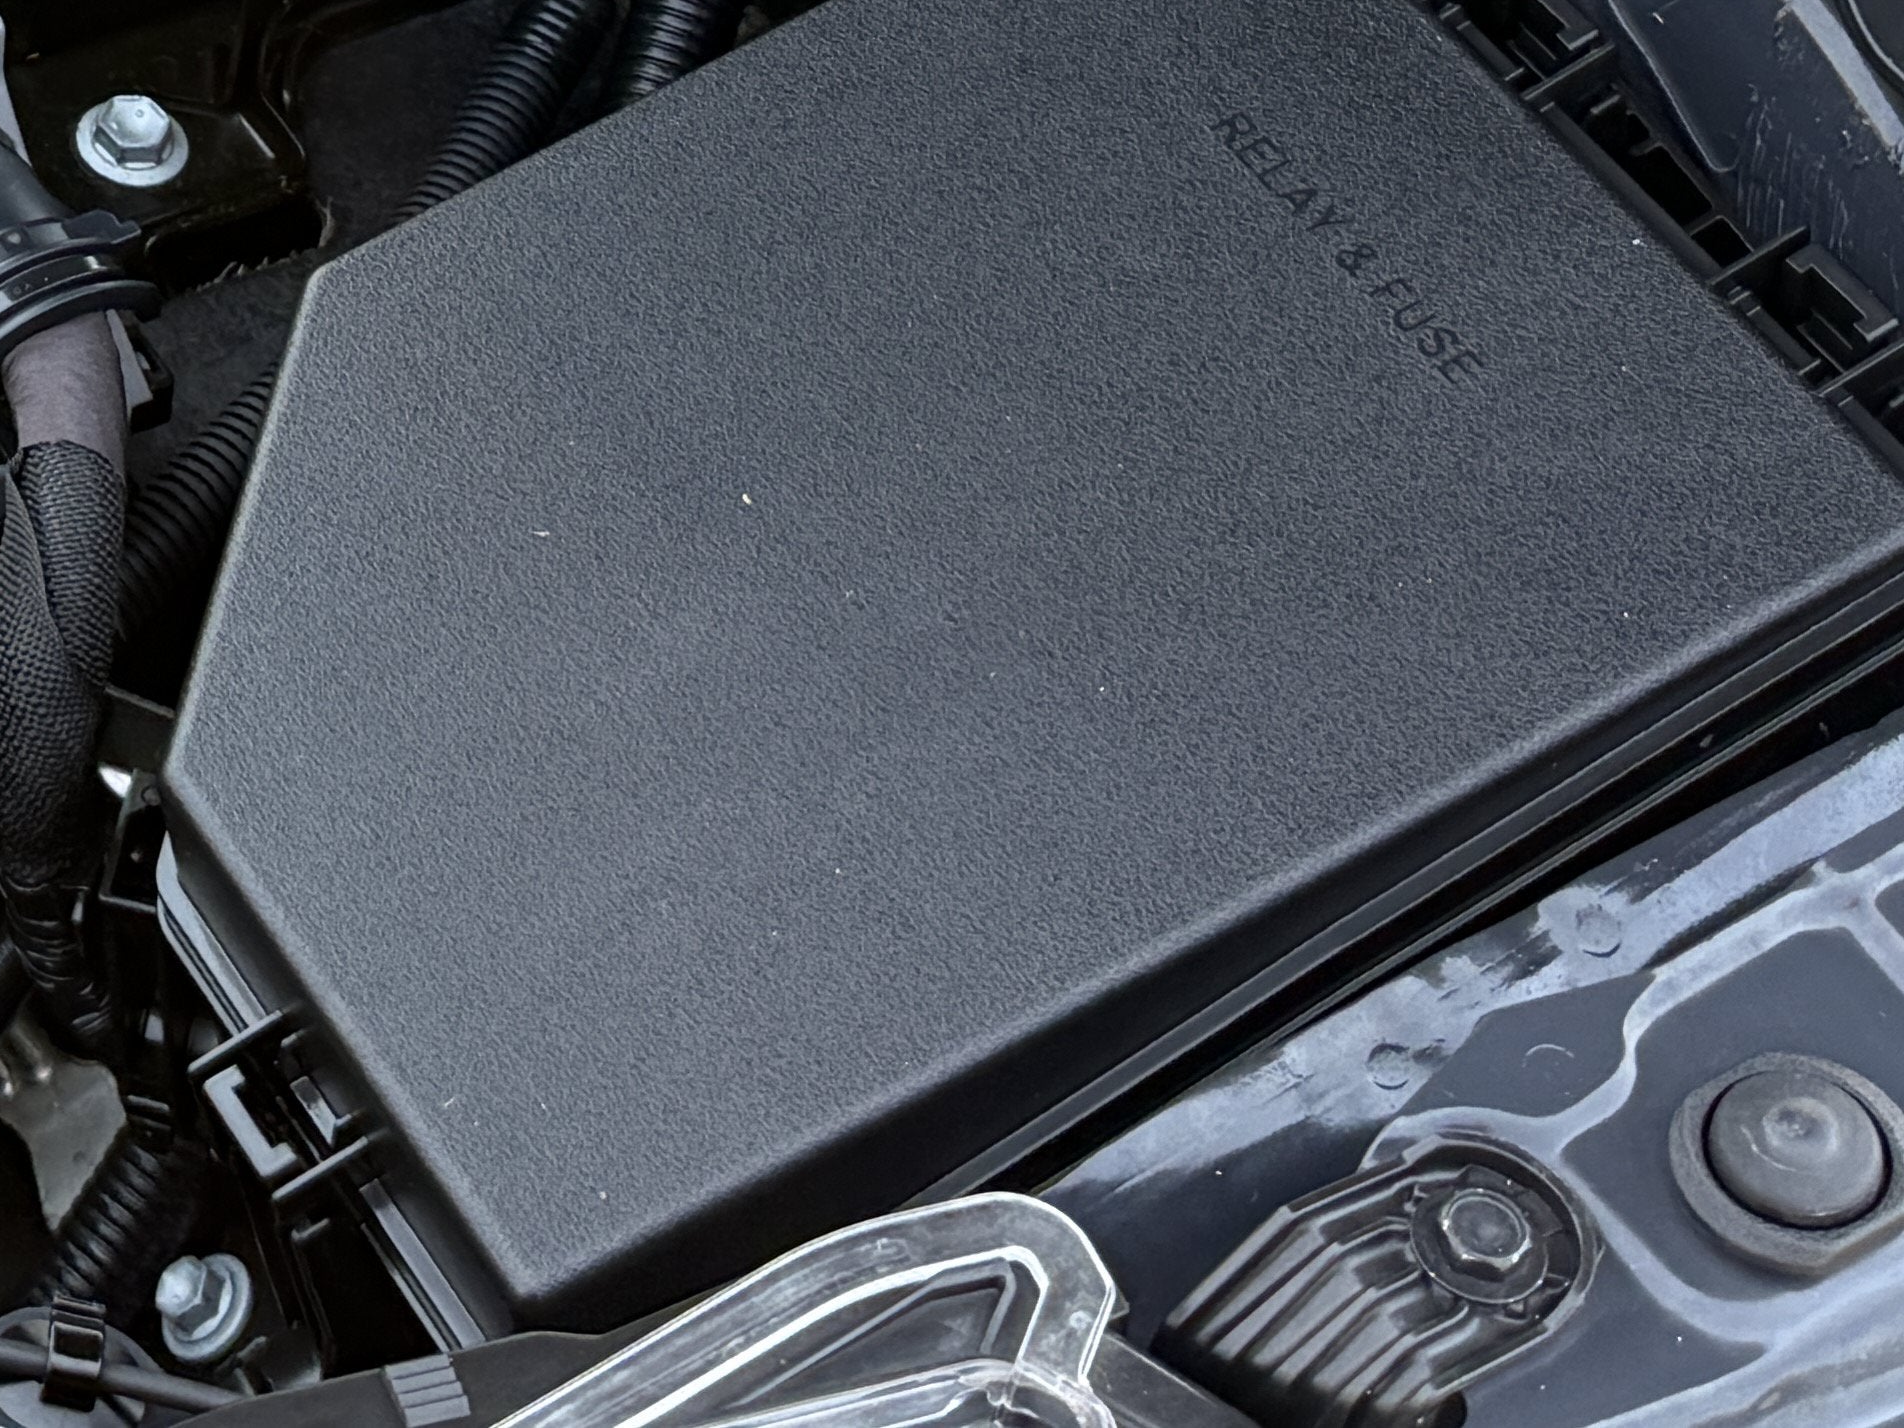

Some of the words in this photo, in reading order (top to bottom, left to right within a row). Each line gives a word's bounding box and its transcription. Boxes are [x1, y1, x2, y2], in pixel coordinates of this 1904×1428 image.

[1209, 112, 1345, 232] RELAY
[1334, 243, 1376, 277] &
[1369, 278, 1486, 384] FUSE
